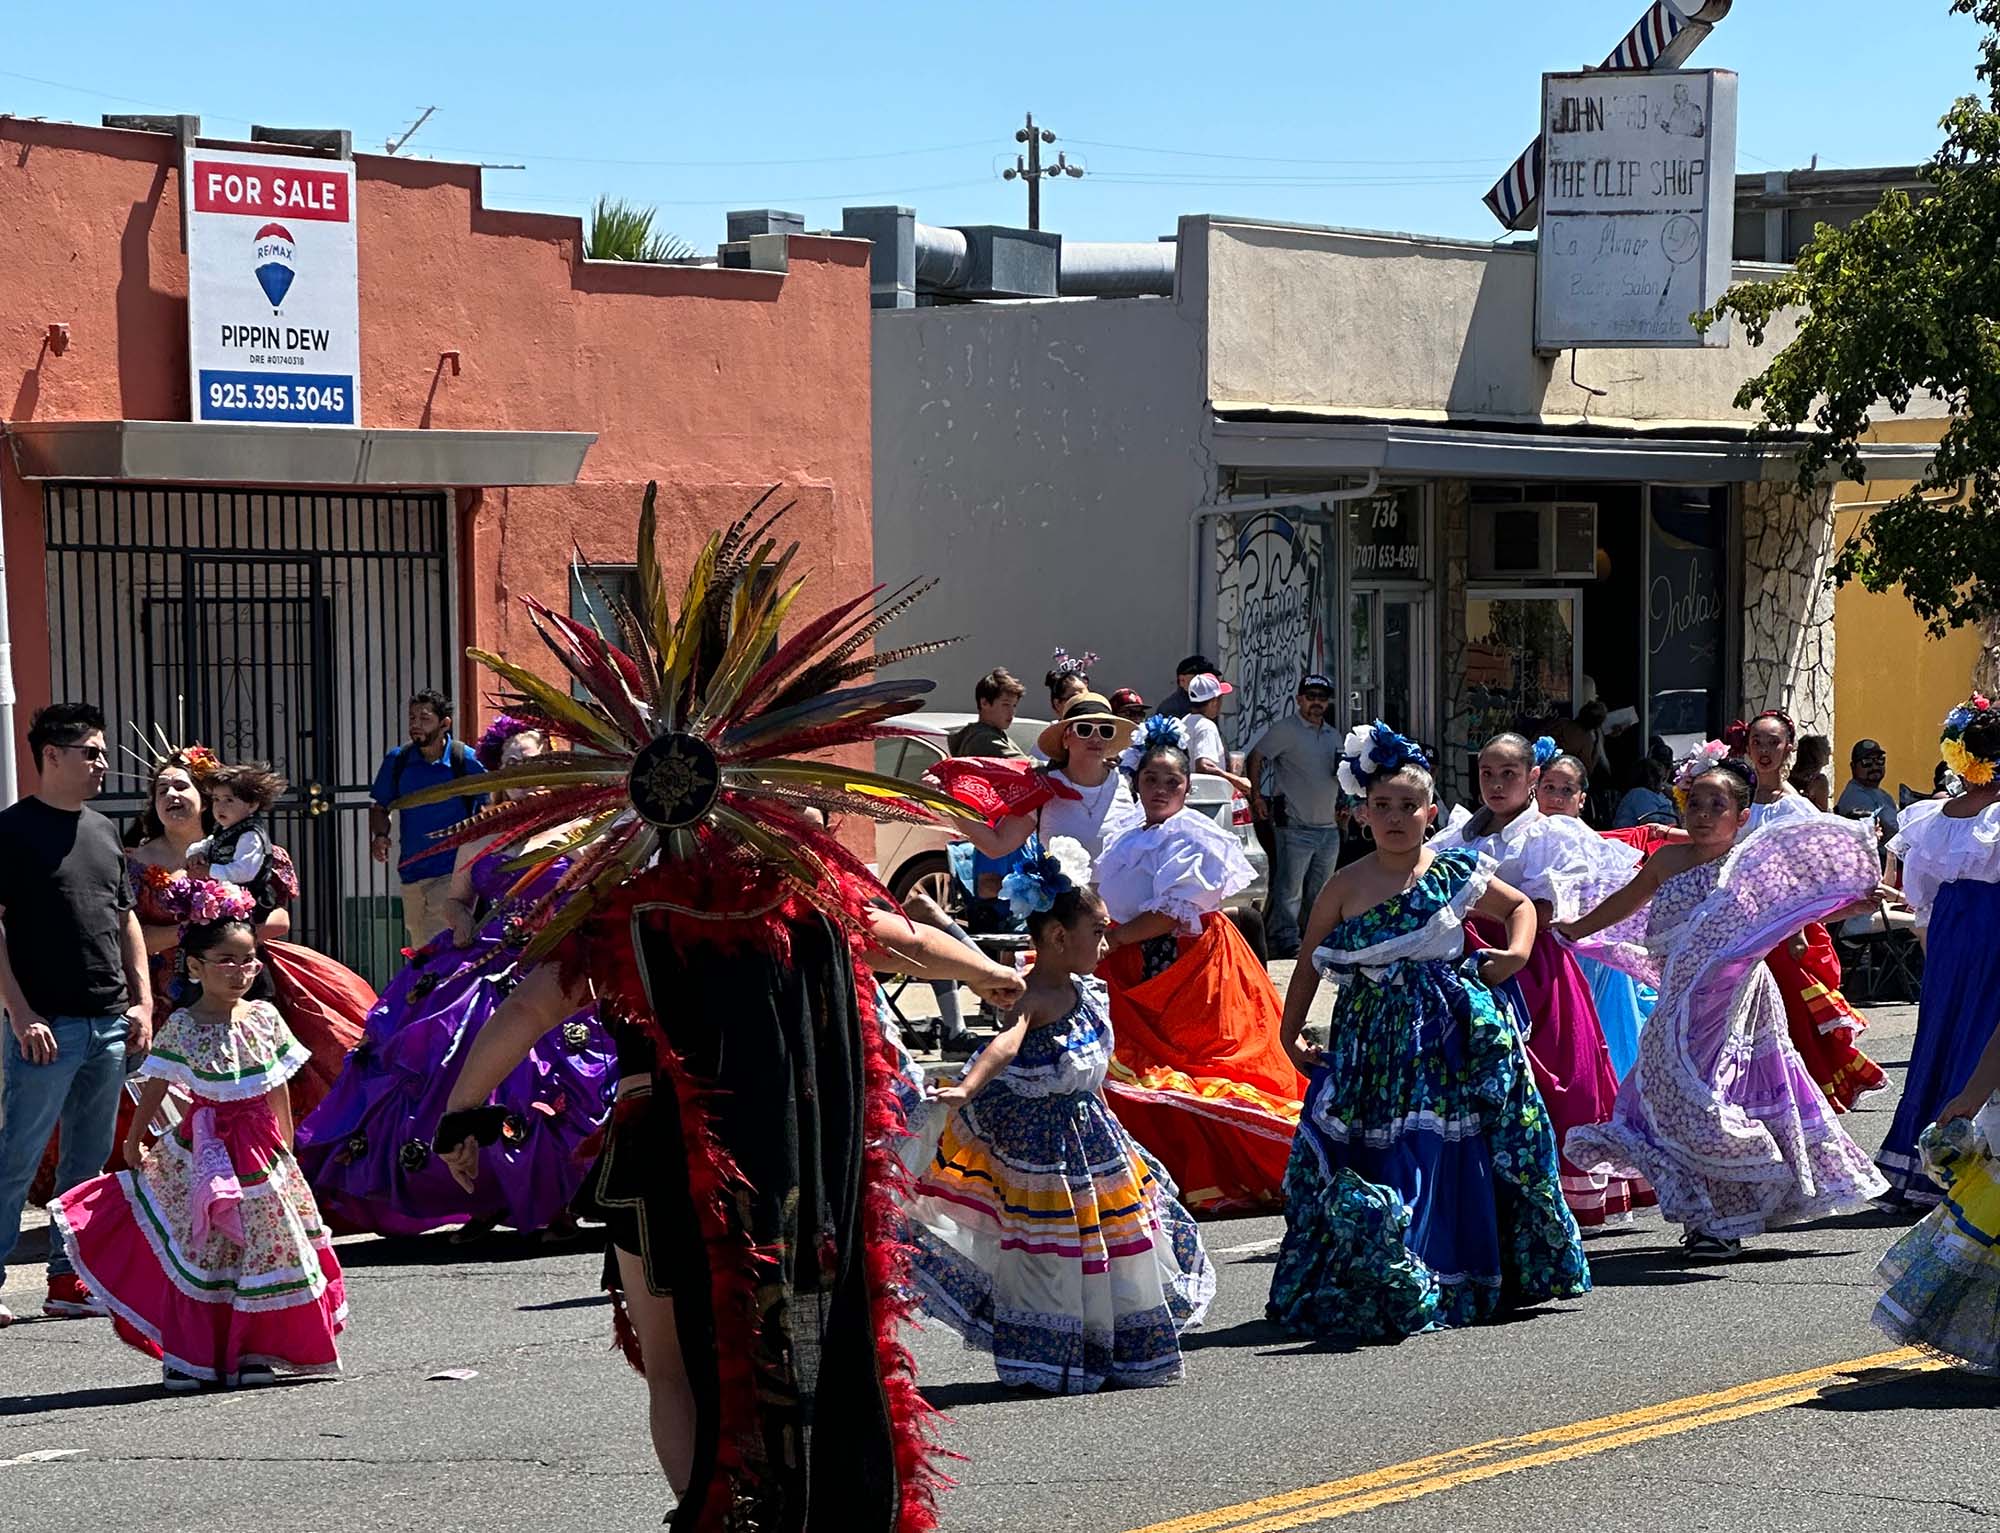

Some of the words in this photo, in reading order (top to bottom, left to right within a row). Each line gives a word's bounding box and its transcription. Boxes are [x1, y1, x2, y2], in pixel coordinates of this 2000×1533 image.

[1552, 95, 1604, 133] JOHN
[207, 173, 262, 205] FOR
[273, 179, 336, 211] SALE
[1549, 159, 1585, 198] THE
[1594, 159, 1641, 197] CLIP
[257, 244, 292, 261] RE/MAX
[222, 325, 280, 349] PIPPIN
[286, 327, 329, 351] DEW
[249, 354, 264, 364] DRE
[209, 383, 344, 412] 925.395.3045
[1372, 500, 1398, 528] 736
[1352, 544, 1376, 570] (707)
[1378, 545, 1419, 568] 653-4391
